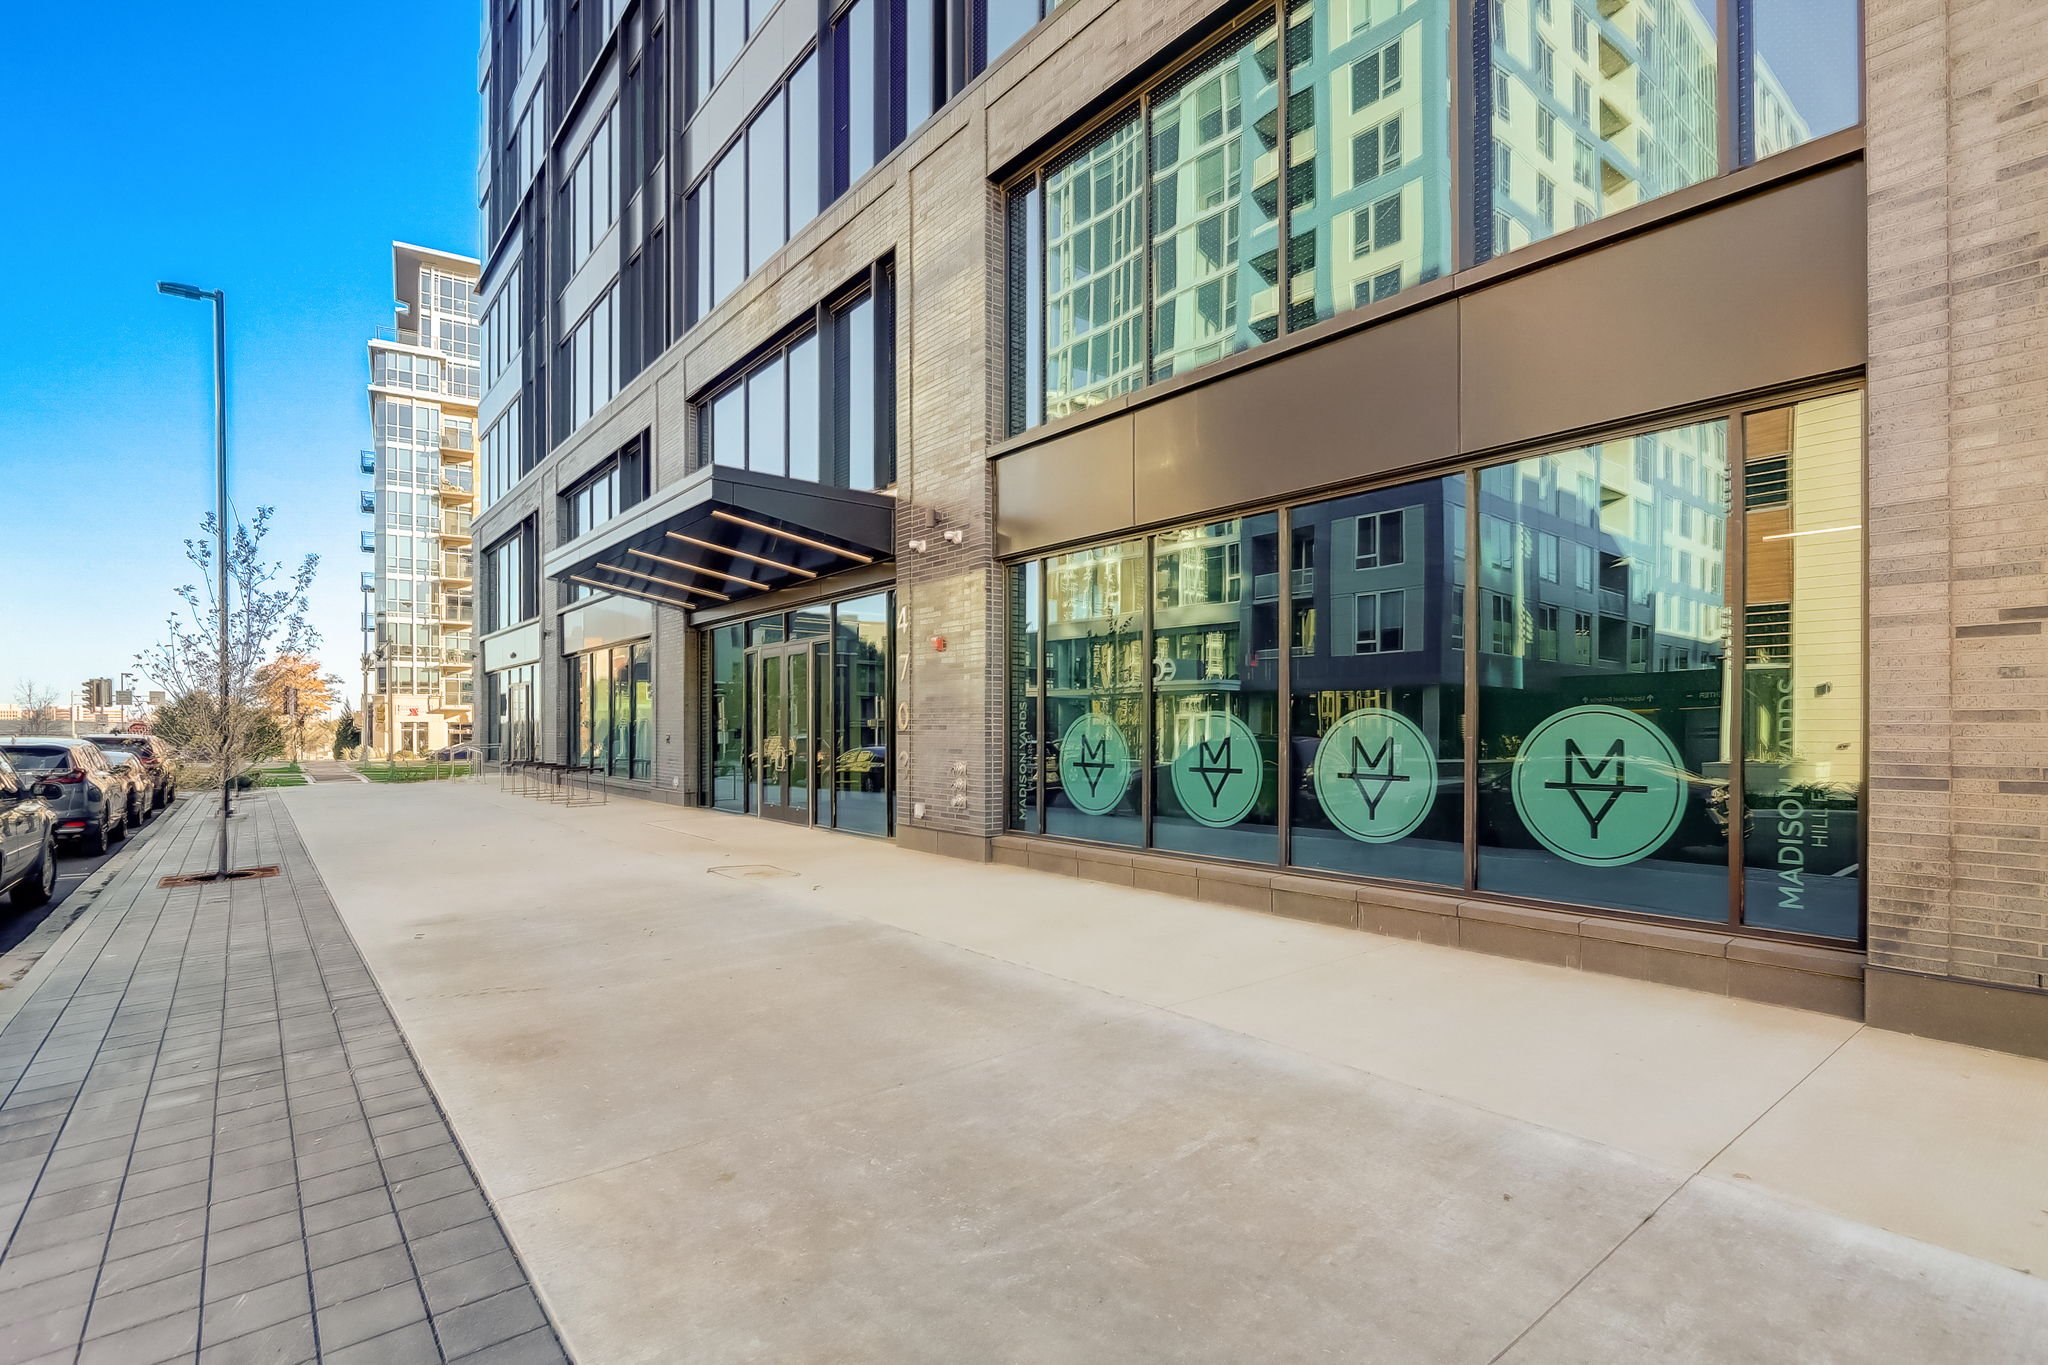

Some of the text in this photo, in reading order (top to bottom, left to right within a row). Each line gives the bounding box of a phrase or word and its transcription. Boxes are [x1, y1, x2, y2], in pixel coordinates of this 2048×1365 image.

[1018, 701, 1028, 821] MADISON YARDS
[1777, 778, 1805, 910] MADISON
[1811, 807, 1829, 847] HILL
